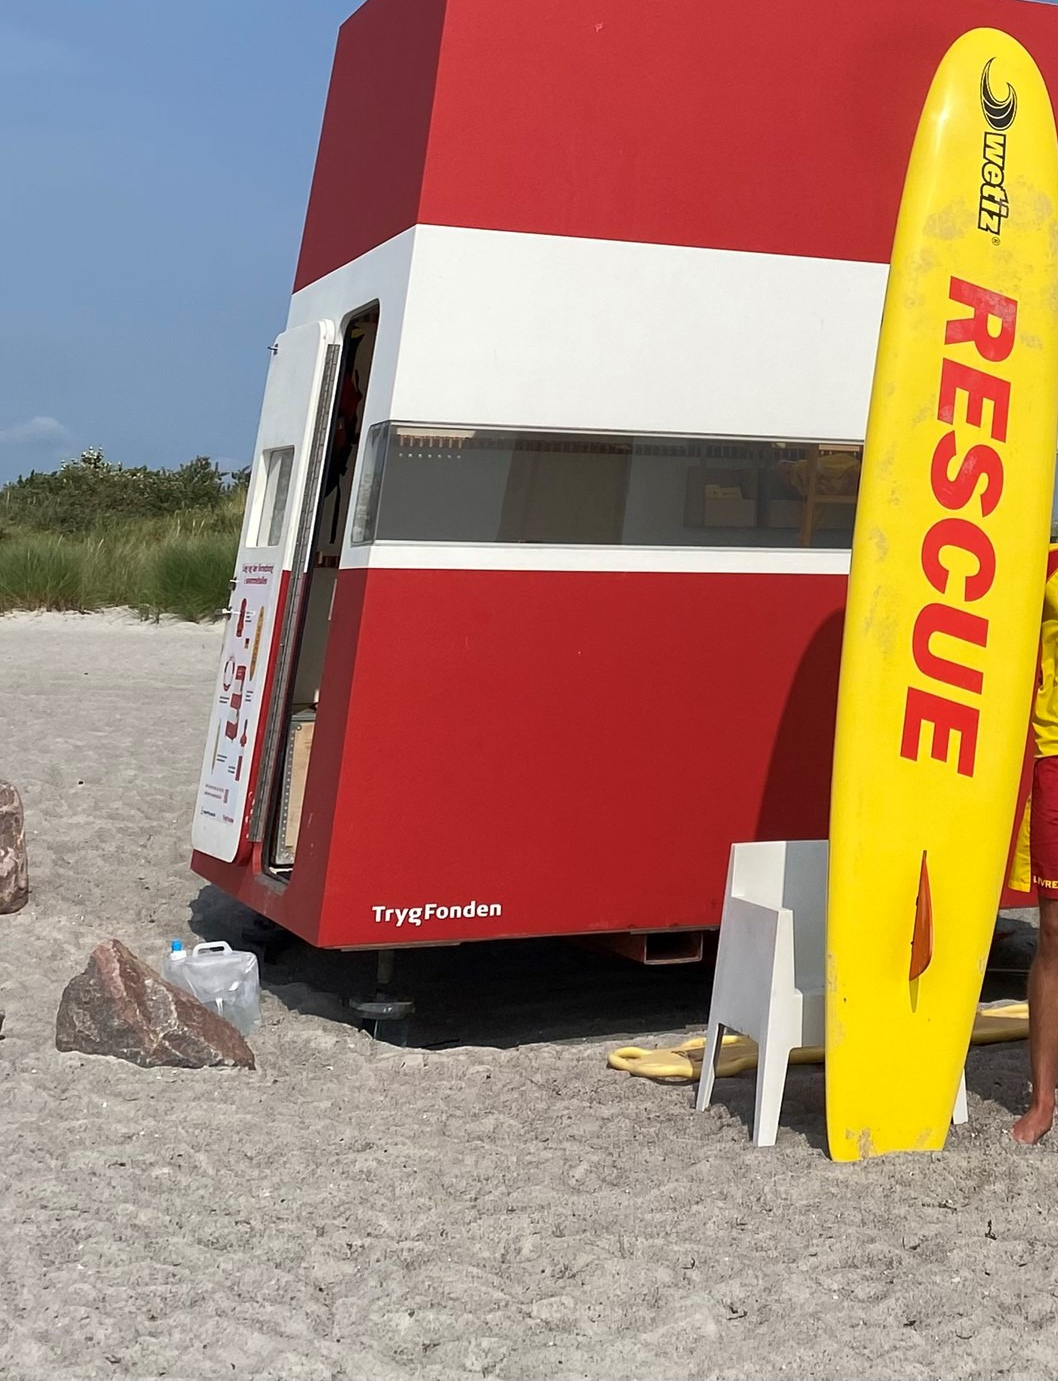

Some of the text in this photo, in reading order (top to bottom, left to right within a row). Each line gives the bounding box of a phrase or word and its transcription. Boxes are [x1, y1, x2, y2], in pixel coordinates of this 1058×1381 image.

[977, 131, 1009, 235] wetiz
[900, 275, 1018, 779] RESCUE
[372, 900, 502, 927] TrygFonden
